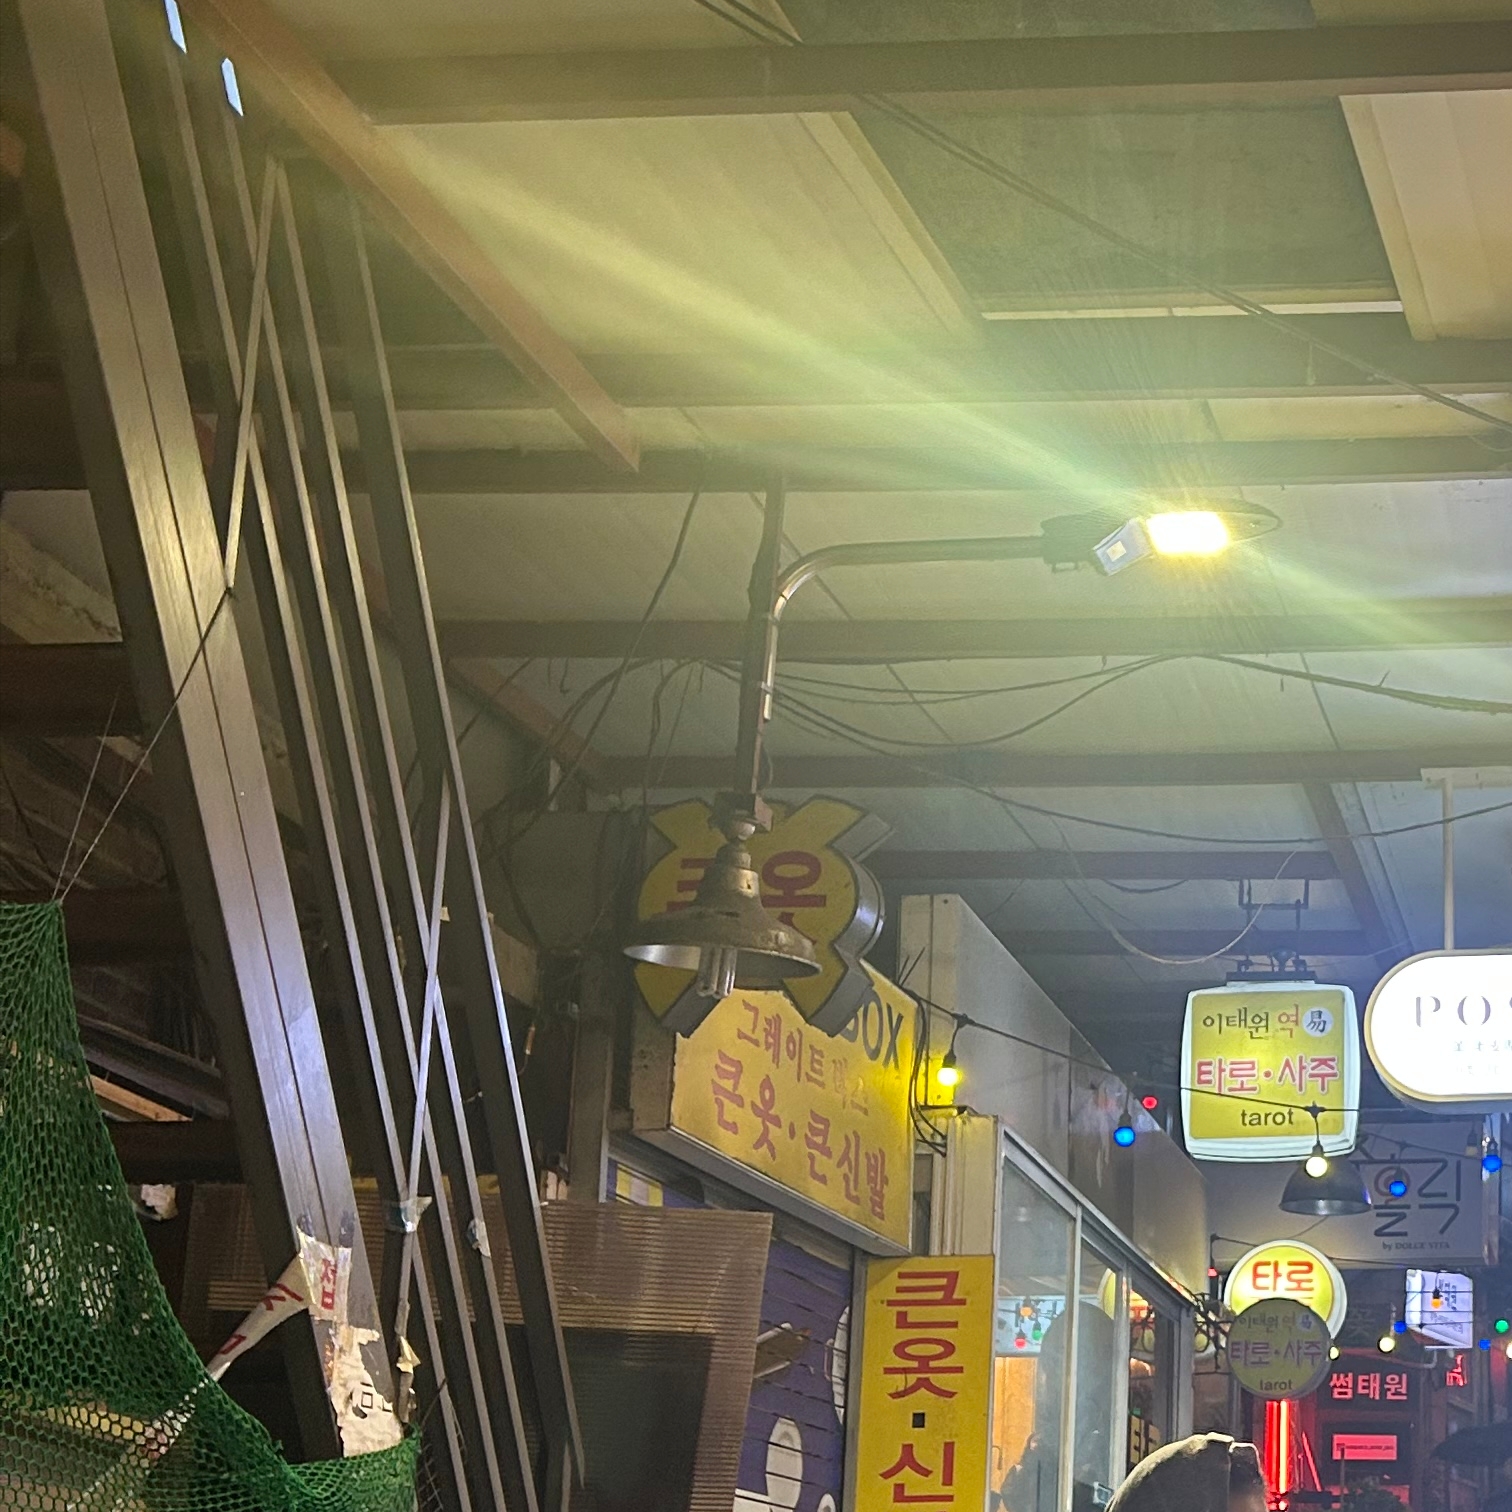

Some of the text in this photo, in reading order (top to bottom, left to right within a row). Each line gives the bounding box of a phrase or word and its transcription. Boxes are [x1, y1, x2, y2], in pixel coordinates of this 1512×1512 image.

[1202, 1003, 1299, 1040] 이태원 역
[1241, 1108, 1294, 1127] tarot
[1252, 1260, 1315, 1292] 타로
[1329, 1372, 1408, 1400] 썸태원
